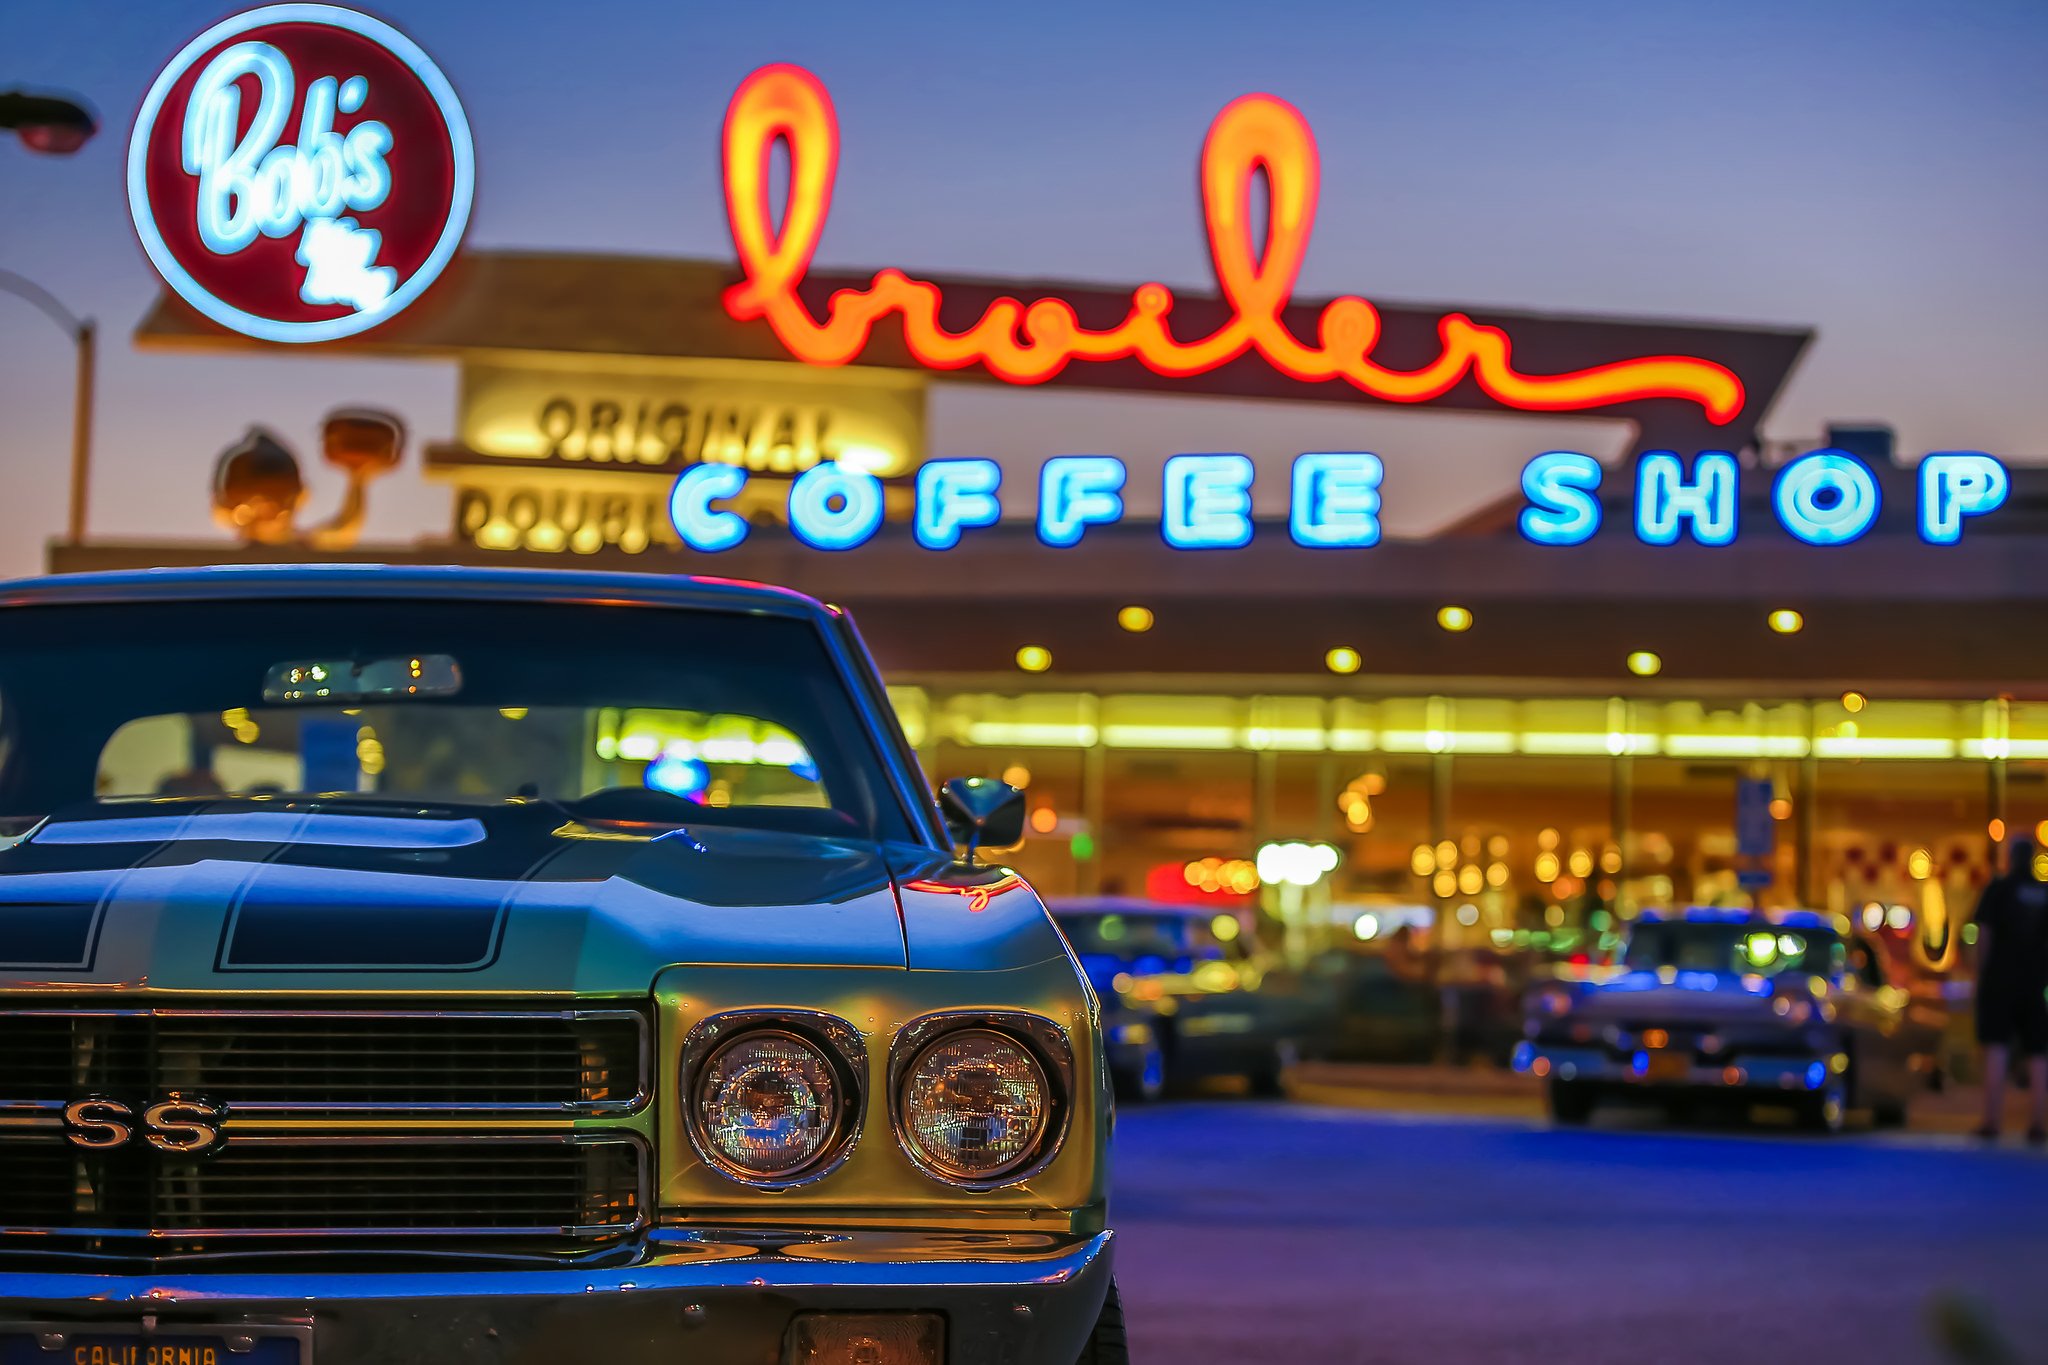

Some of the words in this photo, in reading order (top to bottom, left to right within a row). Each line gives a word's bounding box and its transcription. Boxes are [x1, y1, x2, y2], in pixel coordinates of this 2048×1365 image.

[182, 41, 393, 254] Bob's
[722, 63, 1745, 425] broiler
[459, 485, 684, 546] DOUBL
[670, 452, 1384, 552] COFFEE
[1518, 448, 2012, 547] SHOP
[65, 1098, 217, 1151] SS
